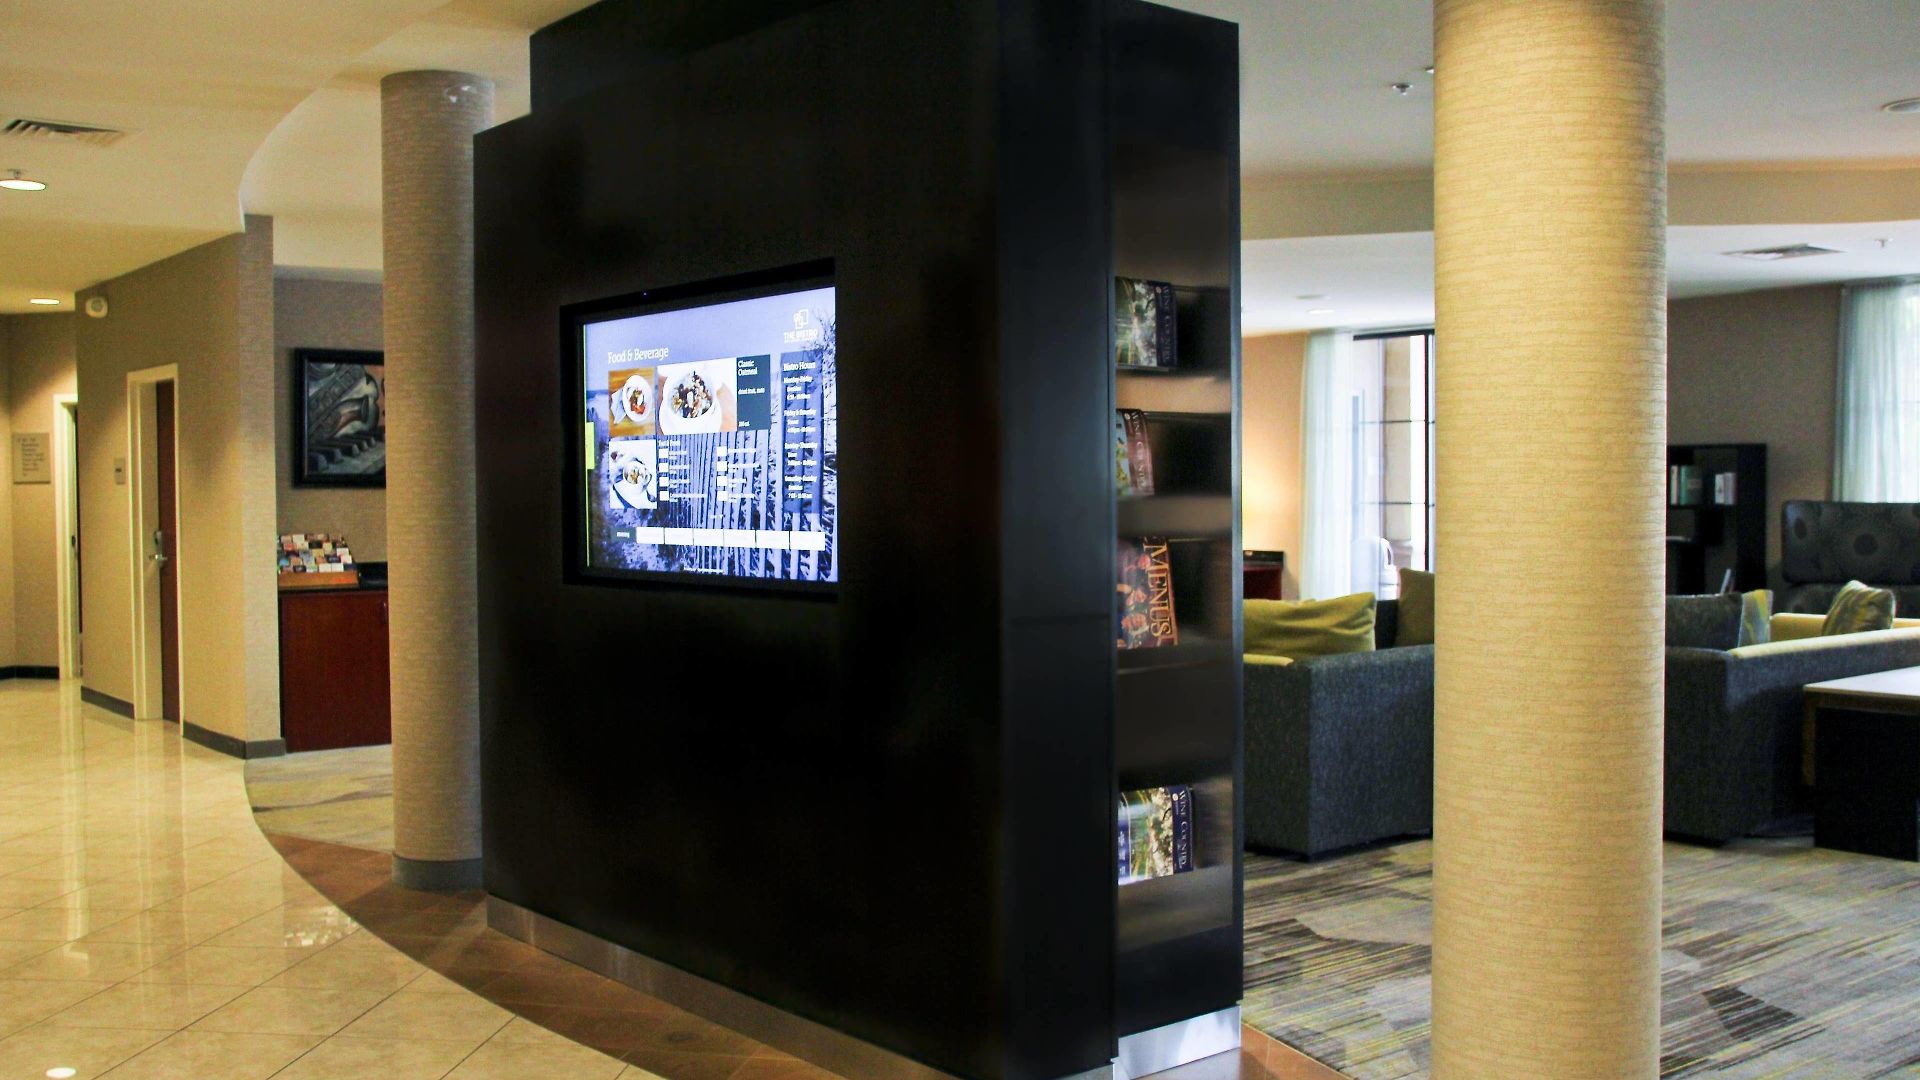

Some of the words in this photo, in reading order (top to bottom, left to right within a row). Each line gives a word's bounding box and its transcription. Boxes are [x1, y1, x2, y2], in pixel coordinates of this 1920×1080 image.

[608, 351, 626, 363] Food
[628, 349, 633, 361] &
[634, 347, 668, 361] Beverage
[1143, 543, 1171, 637] MENUS
